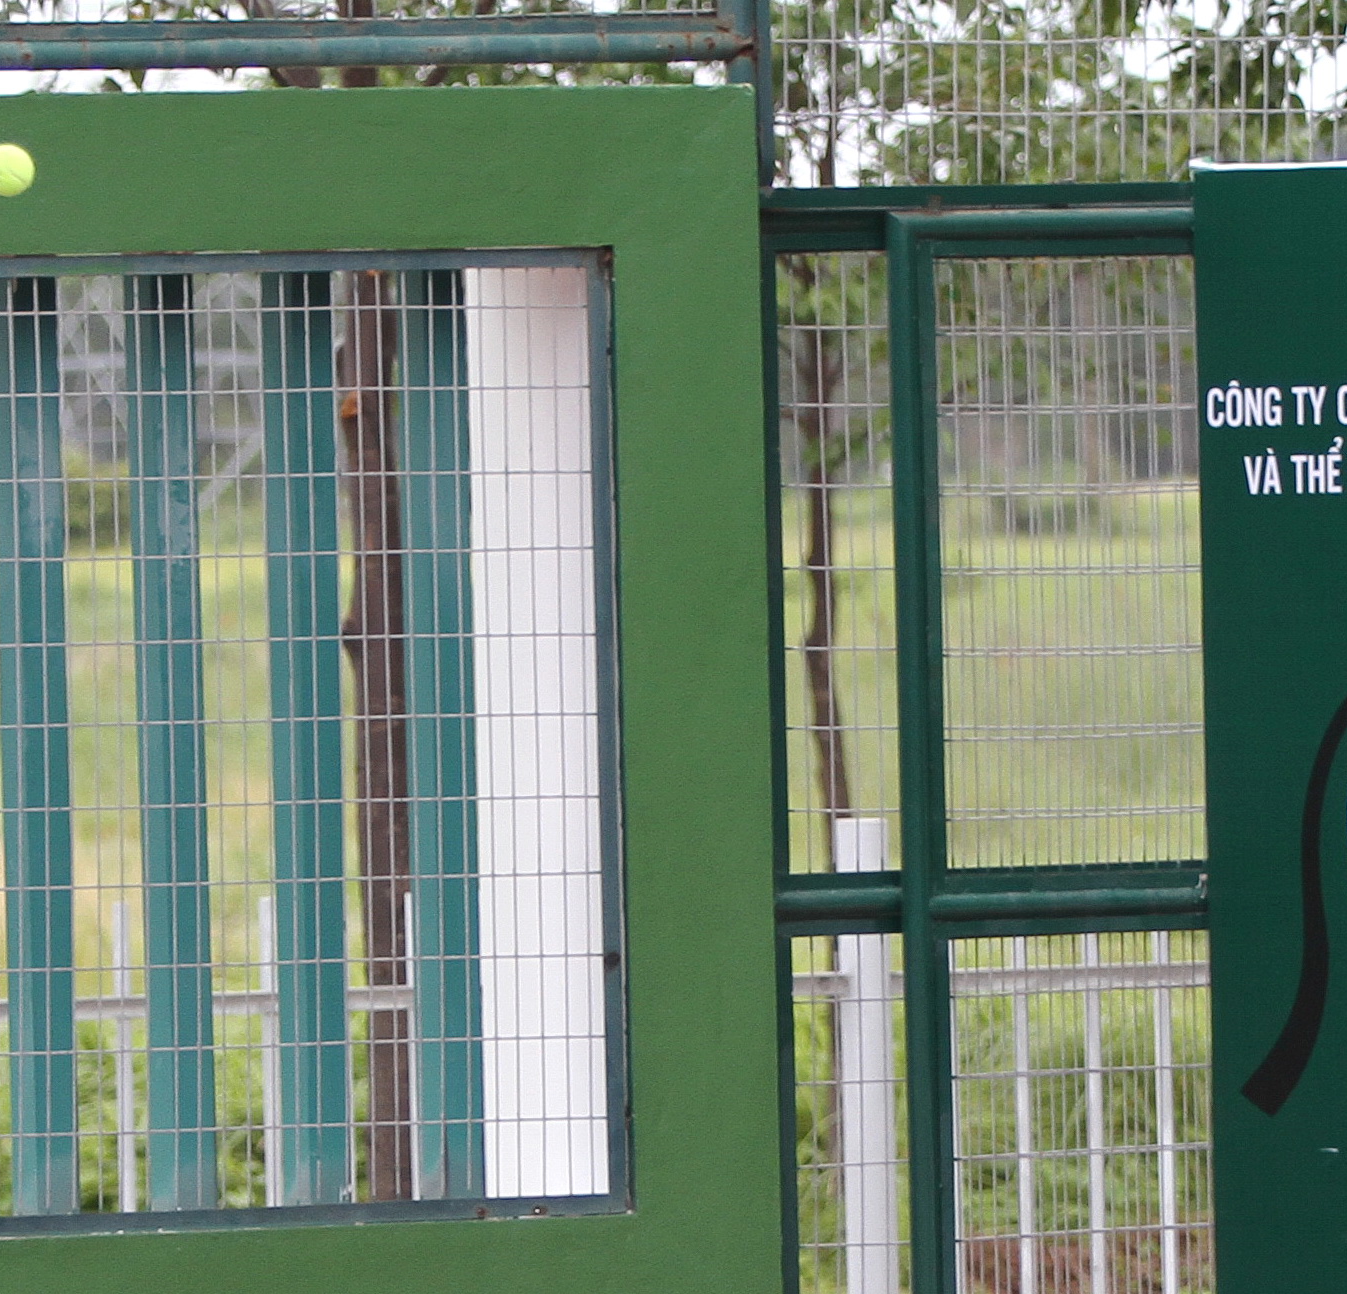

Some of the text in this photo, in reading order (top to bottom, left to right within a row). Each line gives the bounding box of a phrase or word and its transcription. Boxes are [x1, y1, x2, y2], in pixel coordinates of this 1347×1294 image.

[1206, 380, 1282, 427] CÔNG
[1292, 386, 1327, 425] TY
[1244, 448, 1282, 495] VÀ
[1290, 436, 1344, 494] THỂ
